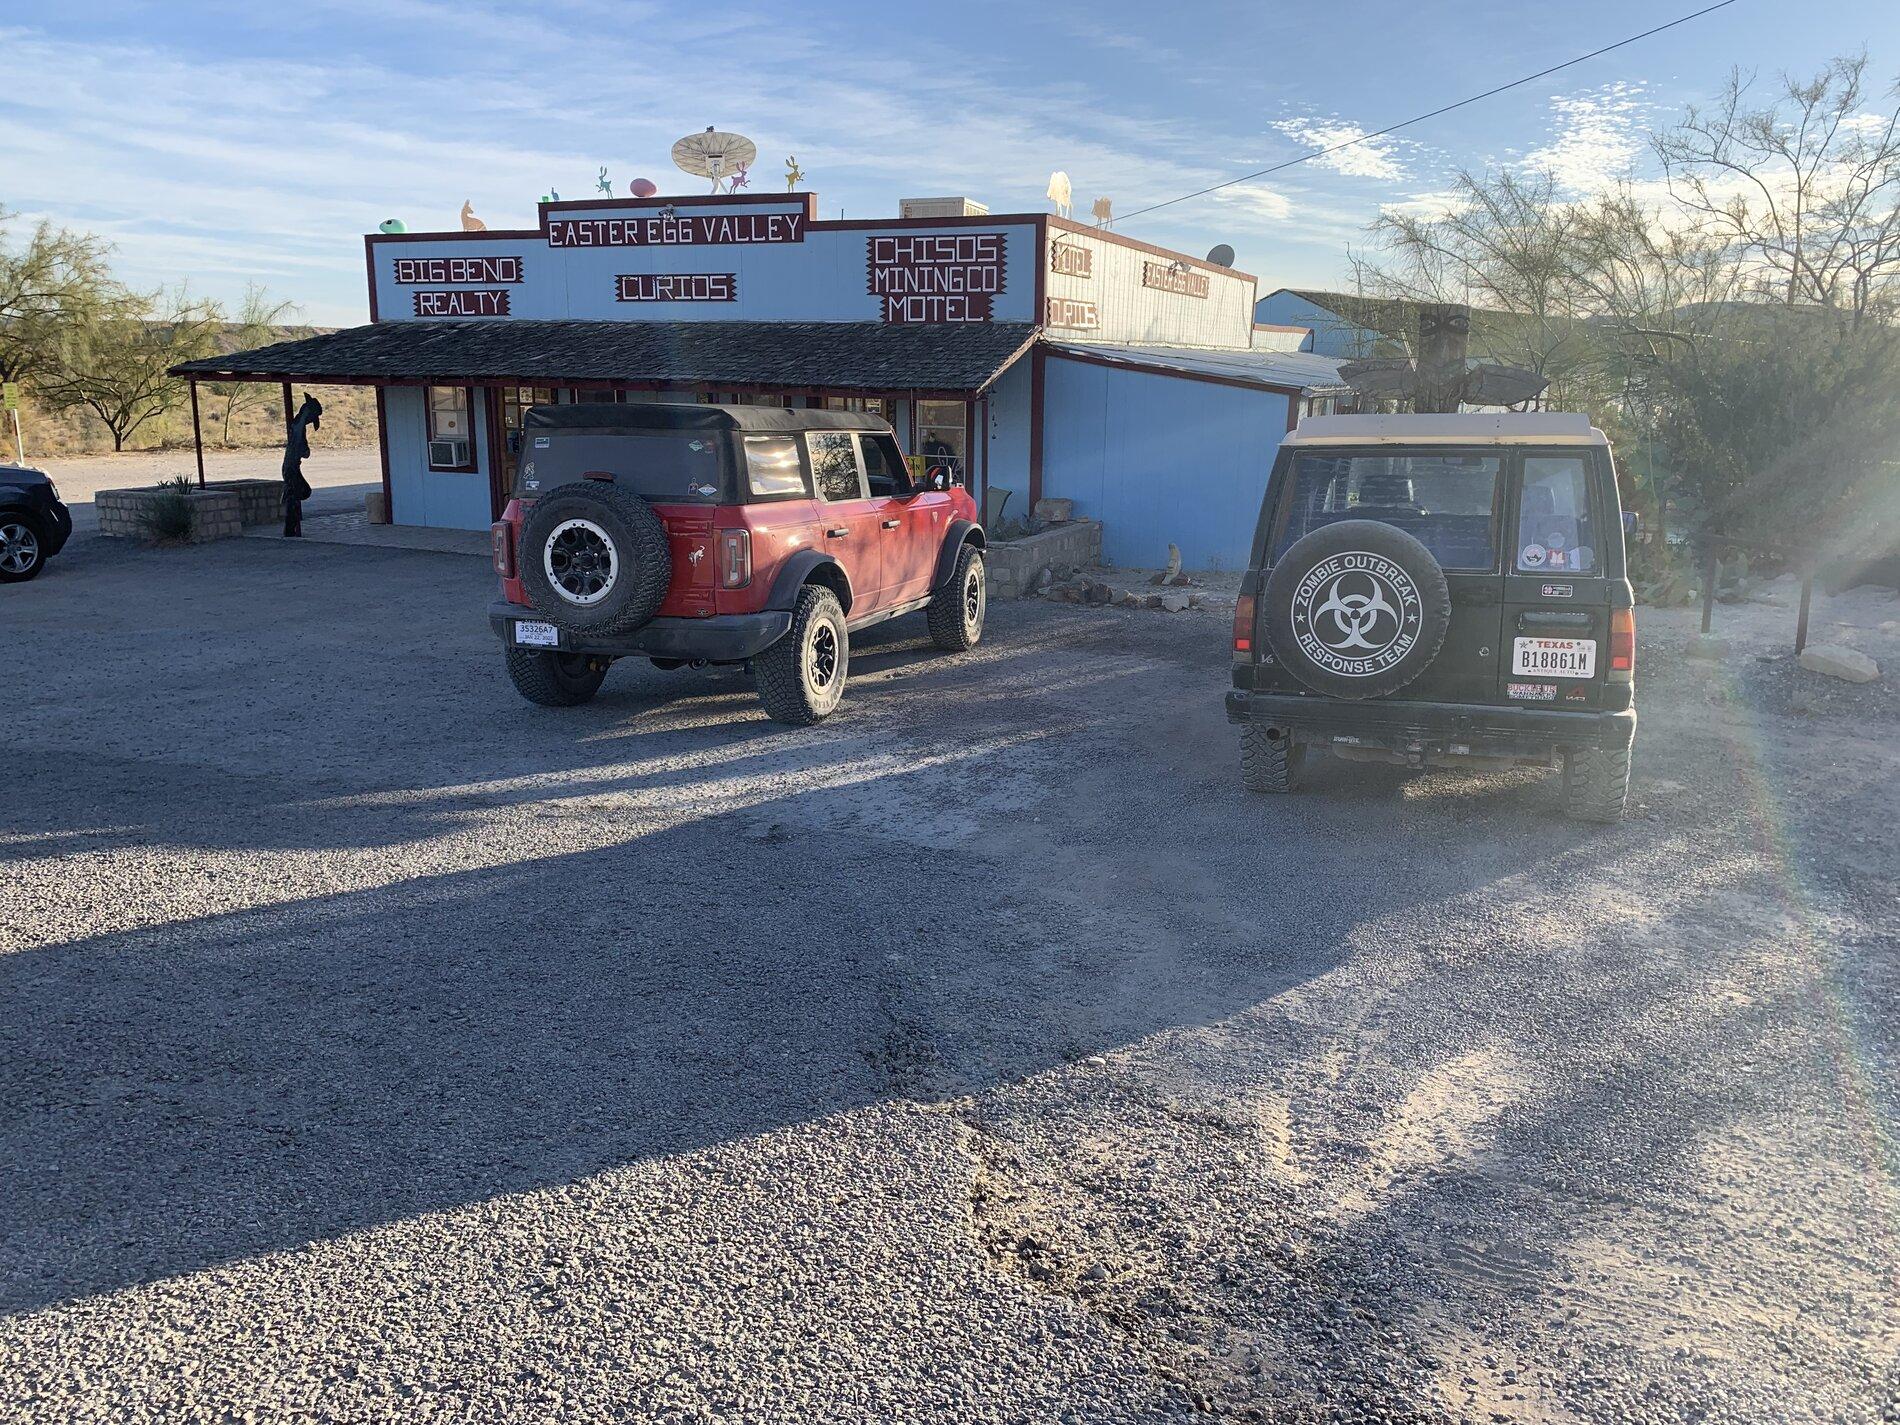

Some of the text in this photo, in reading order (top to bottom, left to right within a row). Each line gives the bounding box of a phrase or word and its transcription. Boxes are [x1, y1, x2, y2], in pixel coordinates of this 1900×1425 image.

[549, 215, 800, 245] EASTER EGG VALLEY
[875, 235, 997, 263] CHISOS
[398, 258, 517, 283] BIG BEND
[875, 266, 997, 293] MINING CO
[622, 275, 728, 300] CURIOS
[419, 291, 501, 315] REALTY
[888, 295, 984, 322] MOTEL
[1050, 300, 1097, 328] CURIOS
[1296, 555, 1418, 607] ZOMBIE OUTBREAK
[1300, 633, 1414, 673] RESPONSE TEAM
[1537, 640, 1574, 649] TEXAS
[1522, 651, 1587, 670] B18861M
